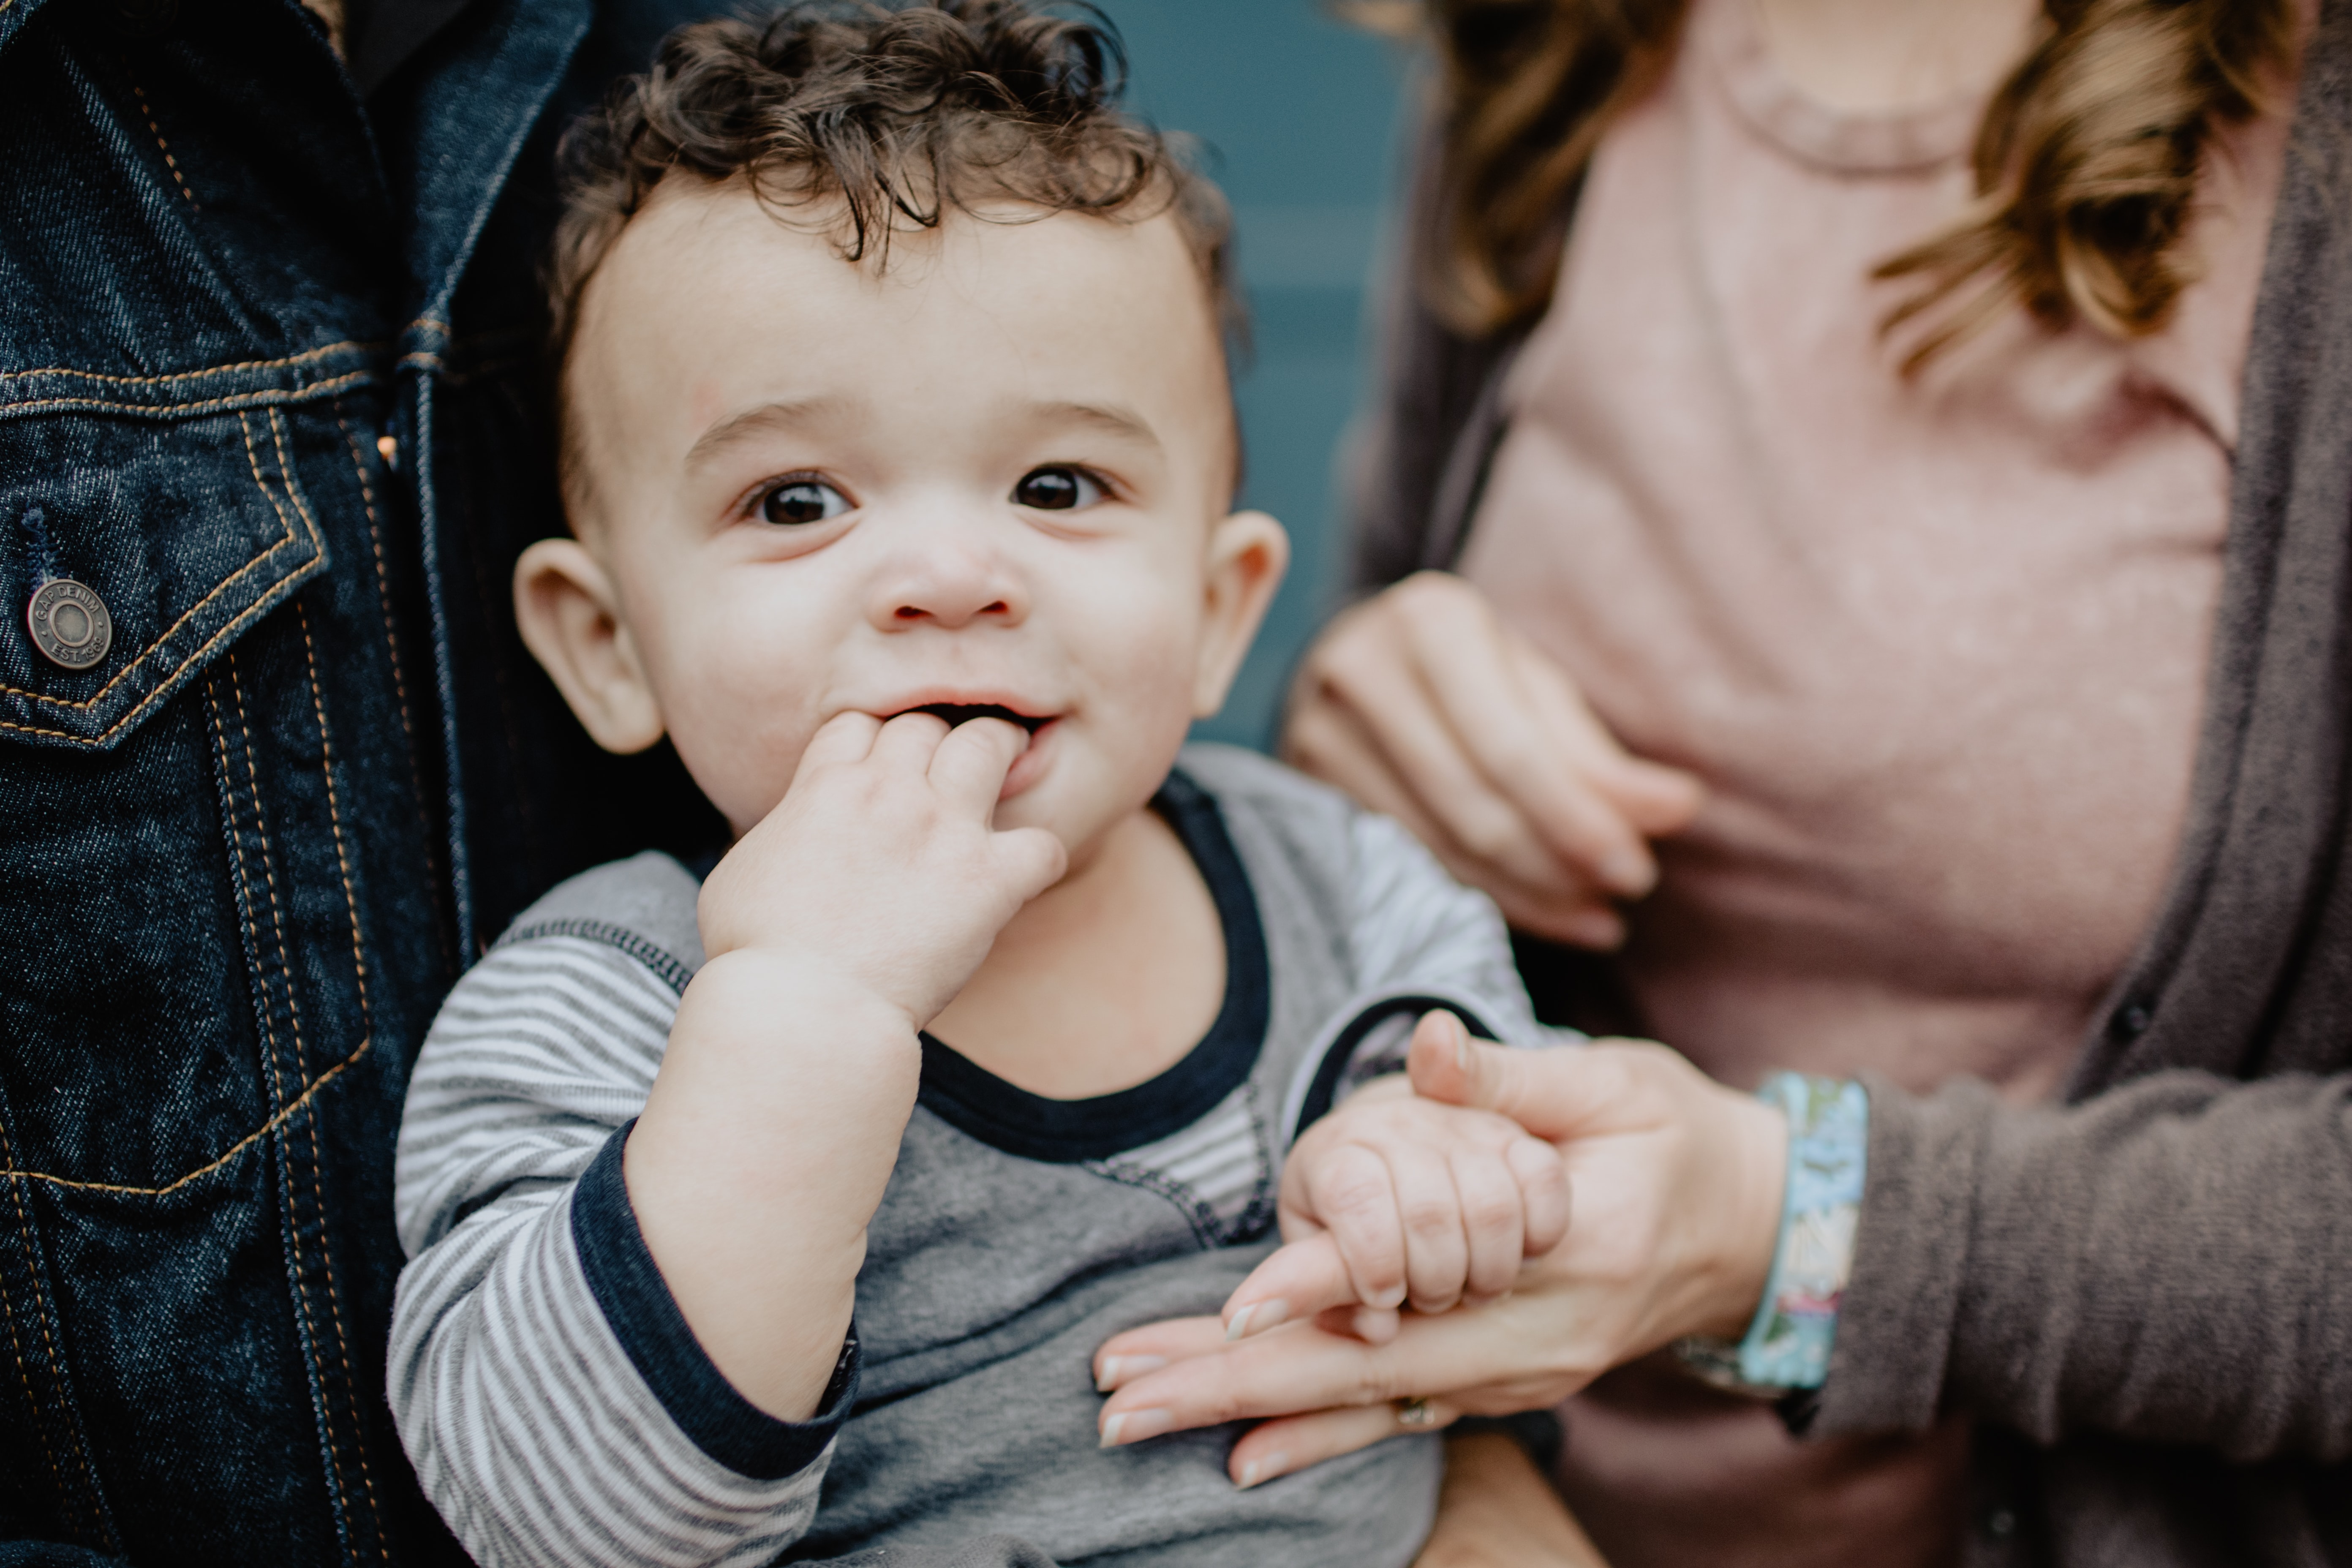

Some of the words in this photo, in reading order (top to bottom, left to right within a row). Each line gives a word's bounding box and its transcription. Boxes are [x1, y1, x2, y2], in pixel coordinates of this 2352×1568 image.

[35, 591, 54, 620] GAP
[57, 586, 100, 613] DENIM
[52, 643, 81, 662] EST.
[82, 637, 104, 659] 1969
